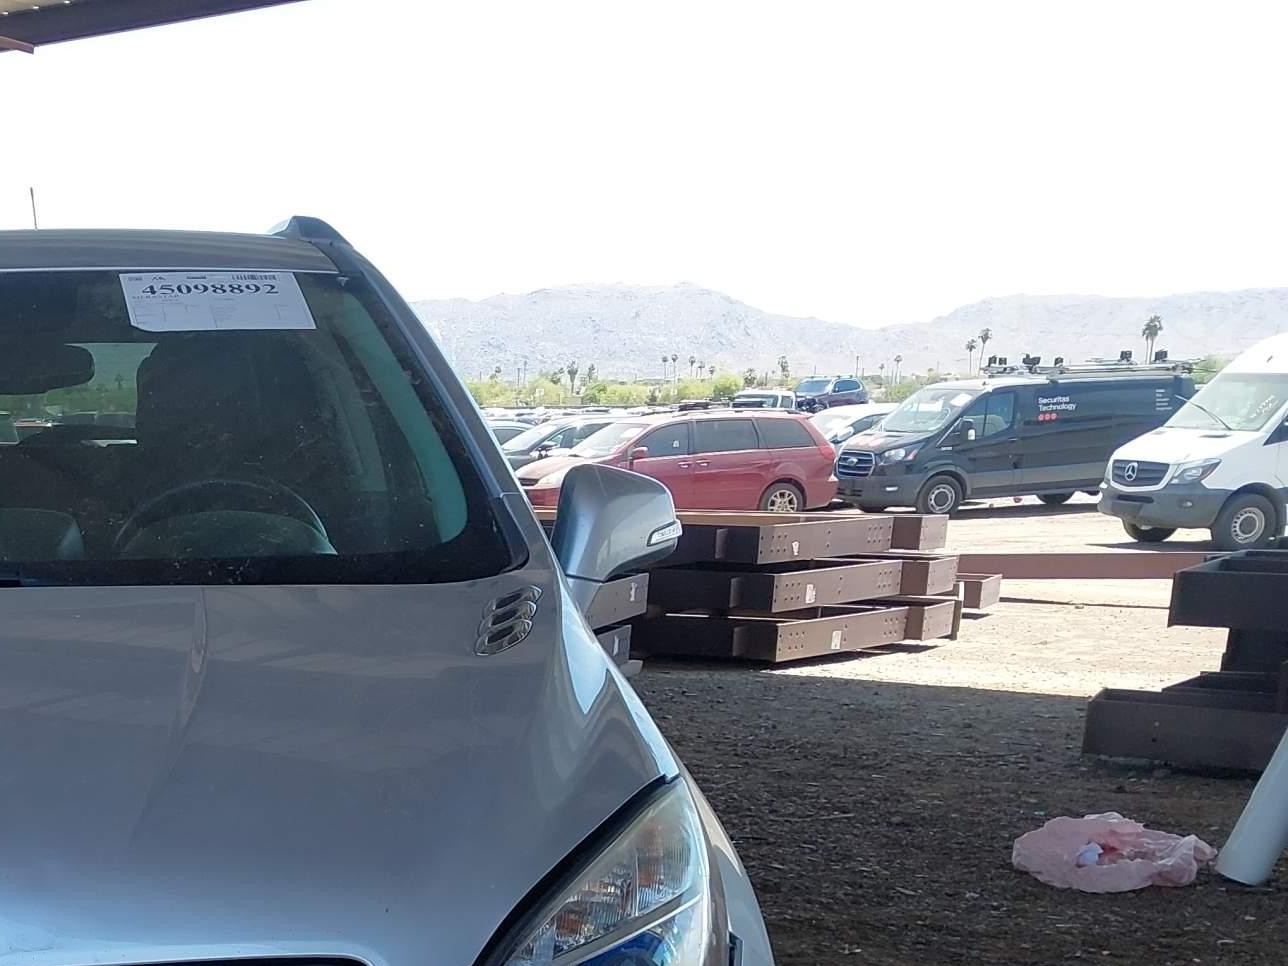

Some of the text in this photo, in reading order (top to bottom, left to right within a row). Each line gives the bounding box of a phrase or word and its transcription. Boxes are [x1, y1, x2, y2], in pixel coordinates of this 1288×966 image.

[142, 283, 280, 295] 45098892
[1038, 396, 1070, 404] Securitas
[1038, 403, 1077, 412] Technology
